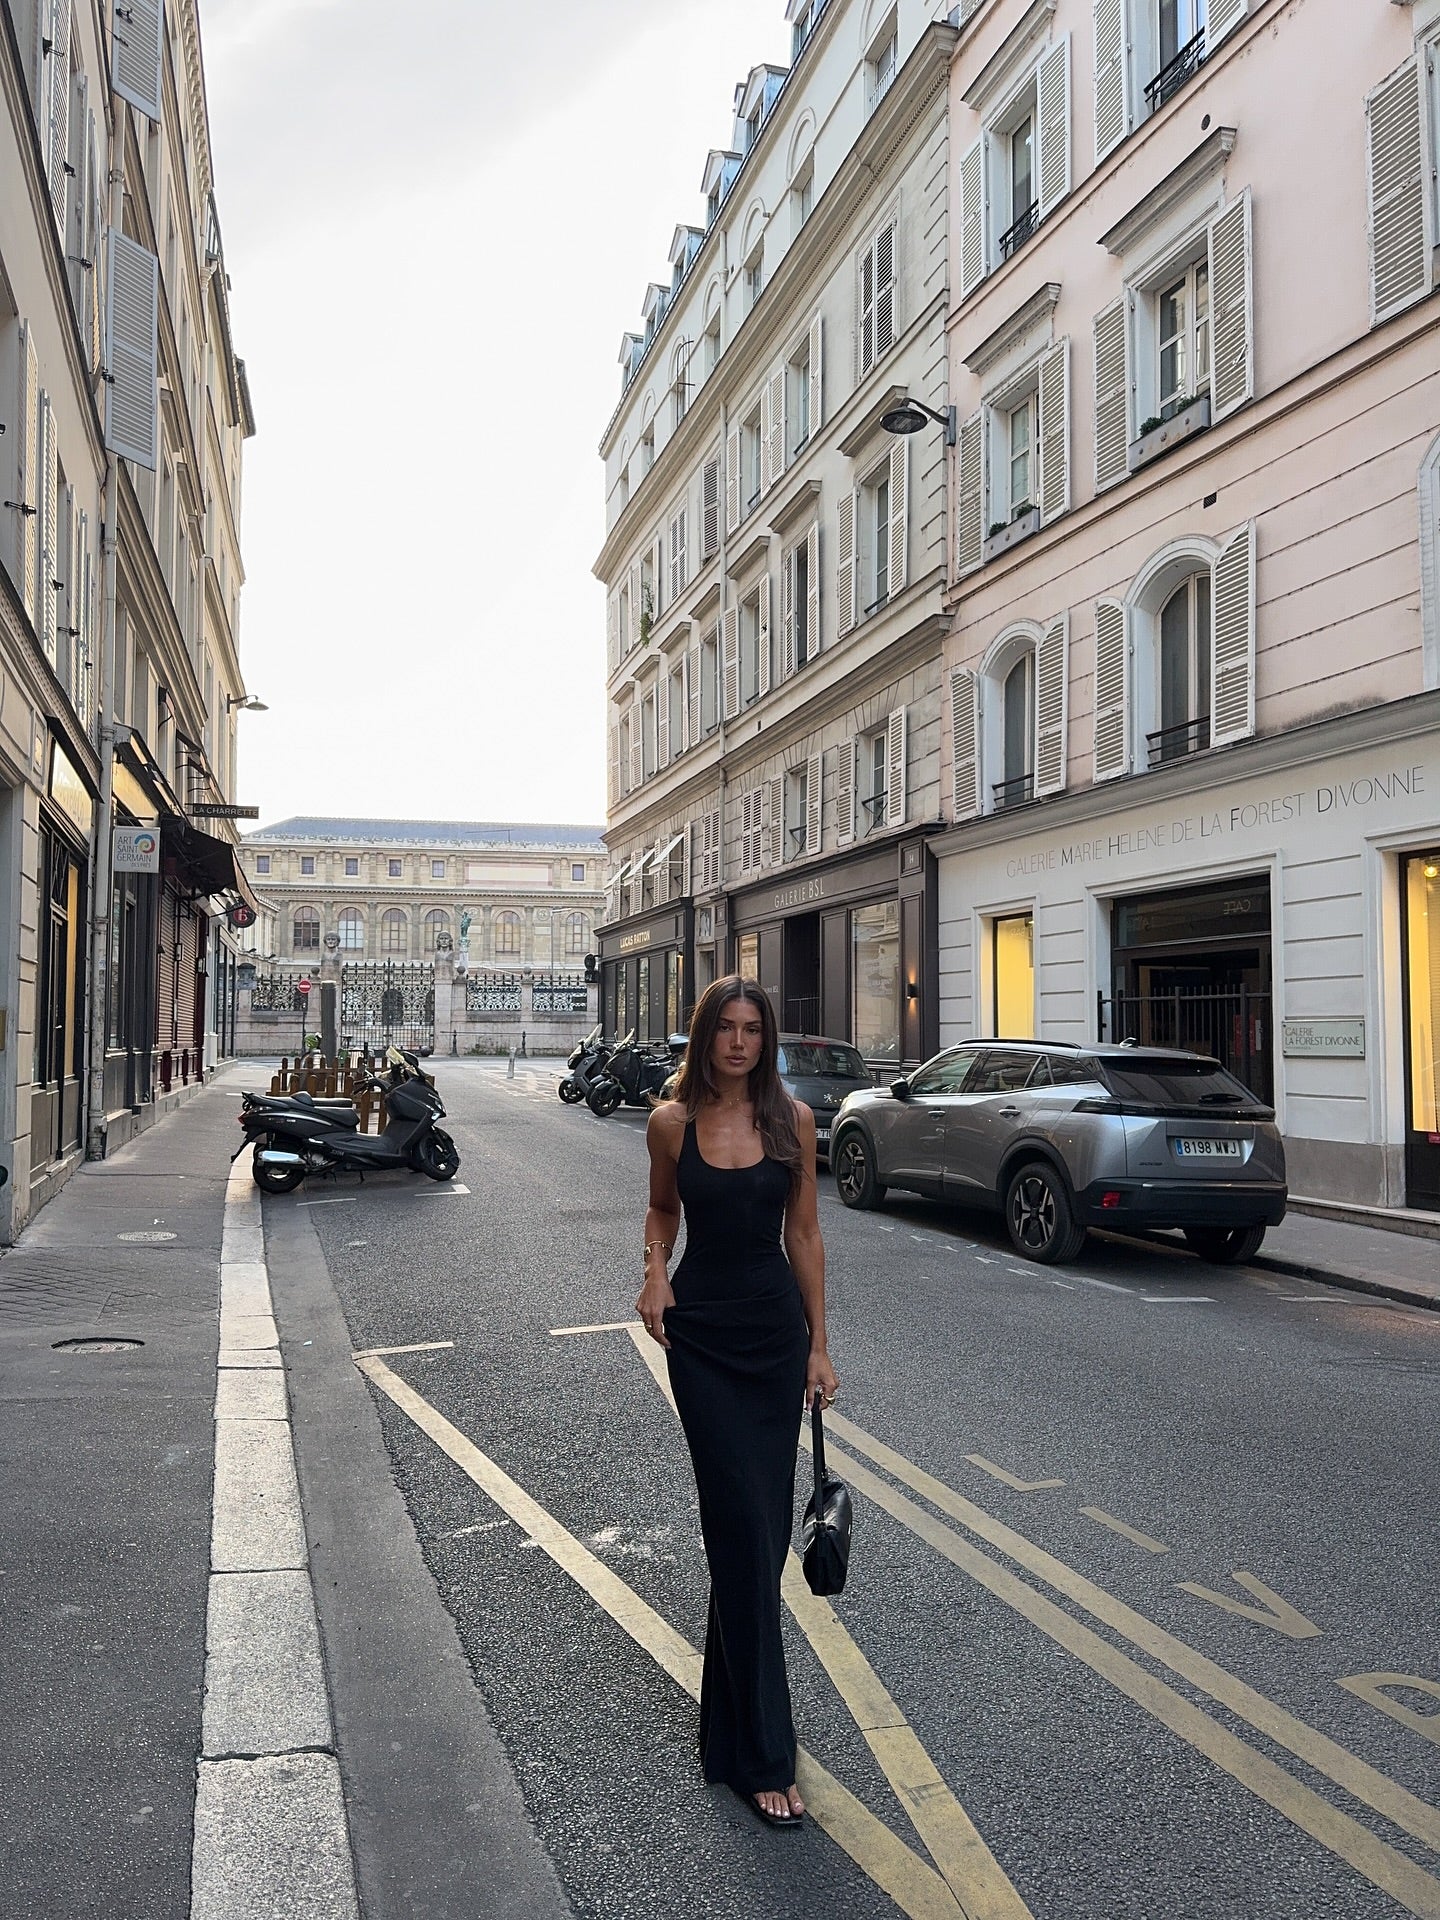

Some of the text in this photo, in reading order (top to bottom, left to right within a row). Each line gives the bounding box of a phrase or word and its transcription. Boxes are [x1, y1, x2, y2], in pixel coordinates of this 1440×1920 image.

[194, 806, 258, 816] LA CHARRETTE
[1006, 765, 1425, 878] GALERIE MARIE HELENE DE LA FOREST DIVONNE
[117, 836, 132, 845] ART
[117, 845, 139, 854] SAINT
[116, 853, 152, 863] GERMAIN
[774, 877, 825, 908] GALERIE BSL
[1284, 1037, 1294, 1046] LA
[1295, 1036, 1323, 1046] FOREST
[1183, 1140, 1212, 1154] 8198
